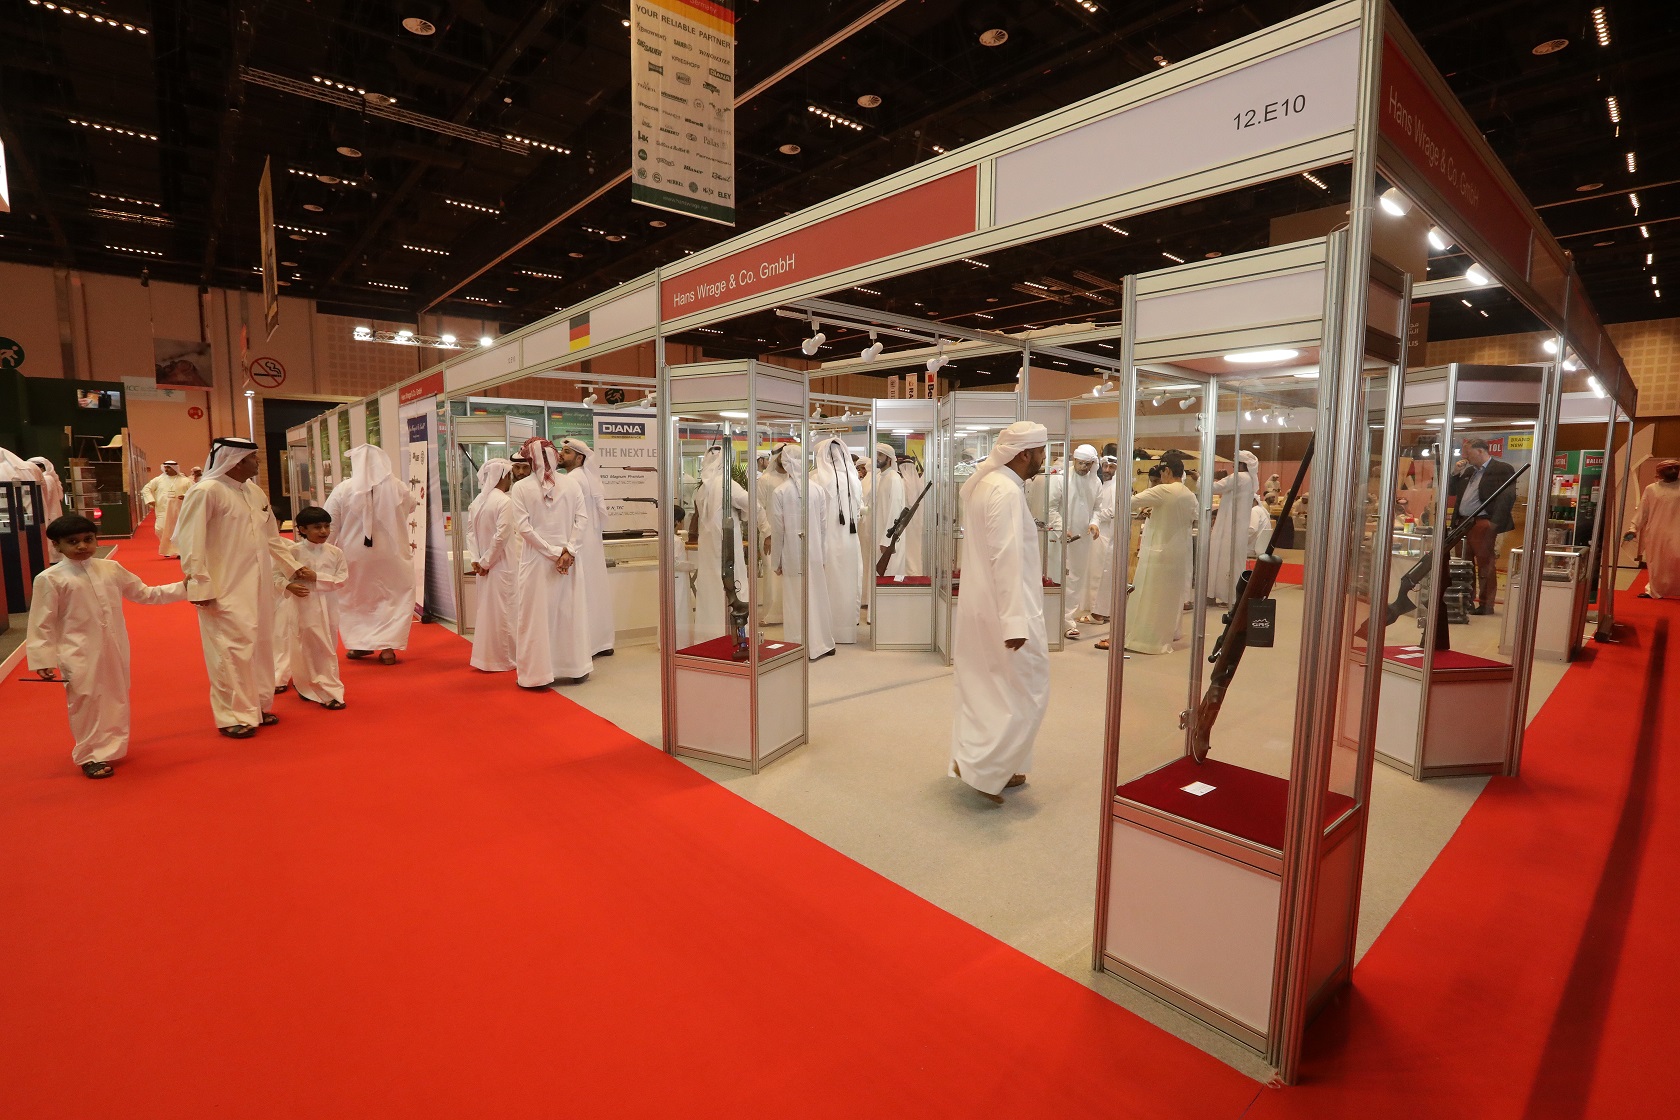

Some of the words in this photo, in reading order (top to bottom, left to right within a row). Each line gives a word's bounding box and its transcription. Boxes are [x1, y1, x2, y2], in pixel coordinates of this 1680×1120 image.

[636, 4, 658, 20] YOUR
[661, 14, 696, 34] RELIABLE
[699, 31, 730, 49] PARTNER
[699, 49, 730, 66] WINCHESTER
[1234, 94, 1306, 130] 12.E10
[1389, 86, 1412, 136] Hans
[1415, 115, 1439, 167] Wrage
[1440, 148, 1445, 174] &
[1448, 157, 1458, 188] Co.
[1460, 172, 1479, 206] GmbH
[718, 191, 732, 200] ELEY
[673, 291, 694, 307] Hans
[696, 280, 726, 298] Wrage
[729, 274, 736, 289] &
[739, 270, 756, 286] Co.
[760, 253, 795, 279] GmbH
[603, 424, 642, 433] DIANA
[599, 448, 617, 457] THE
[620, 448, 644, 457] NEXT
